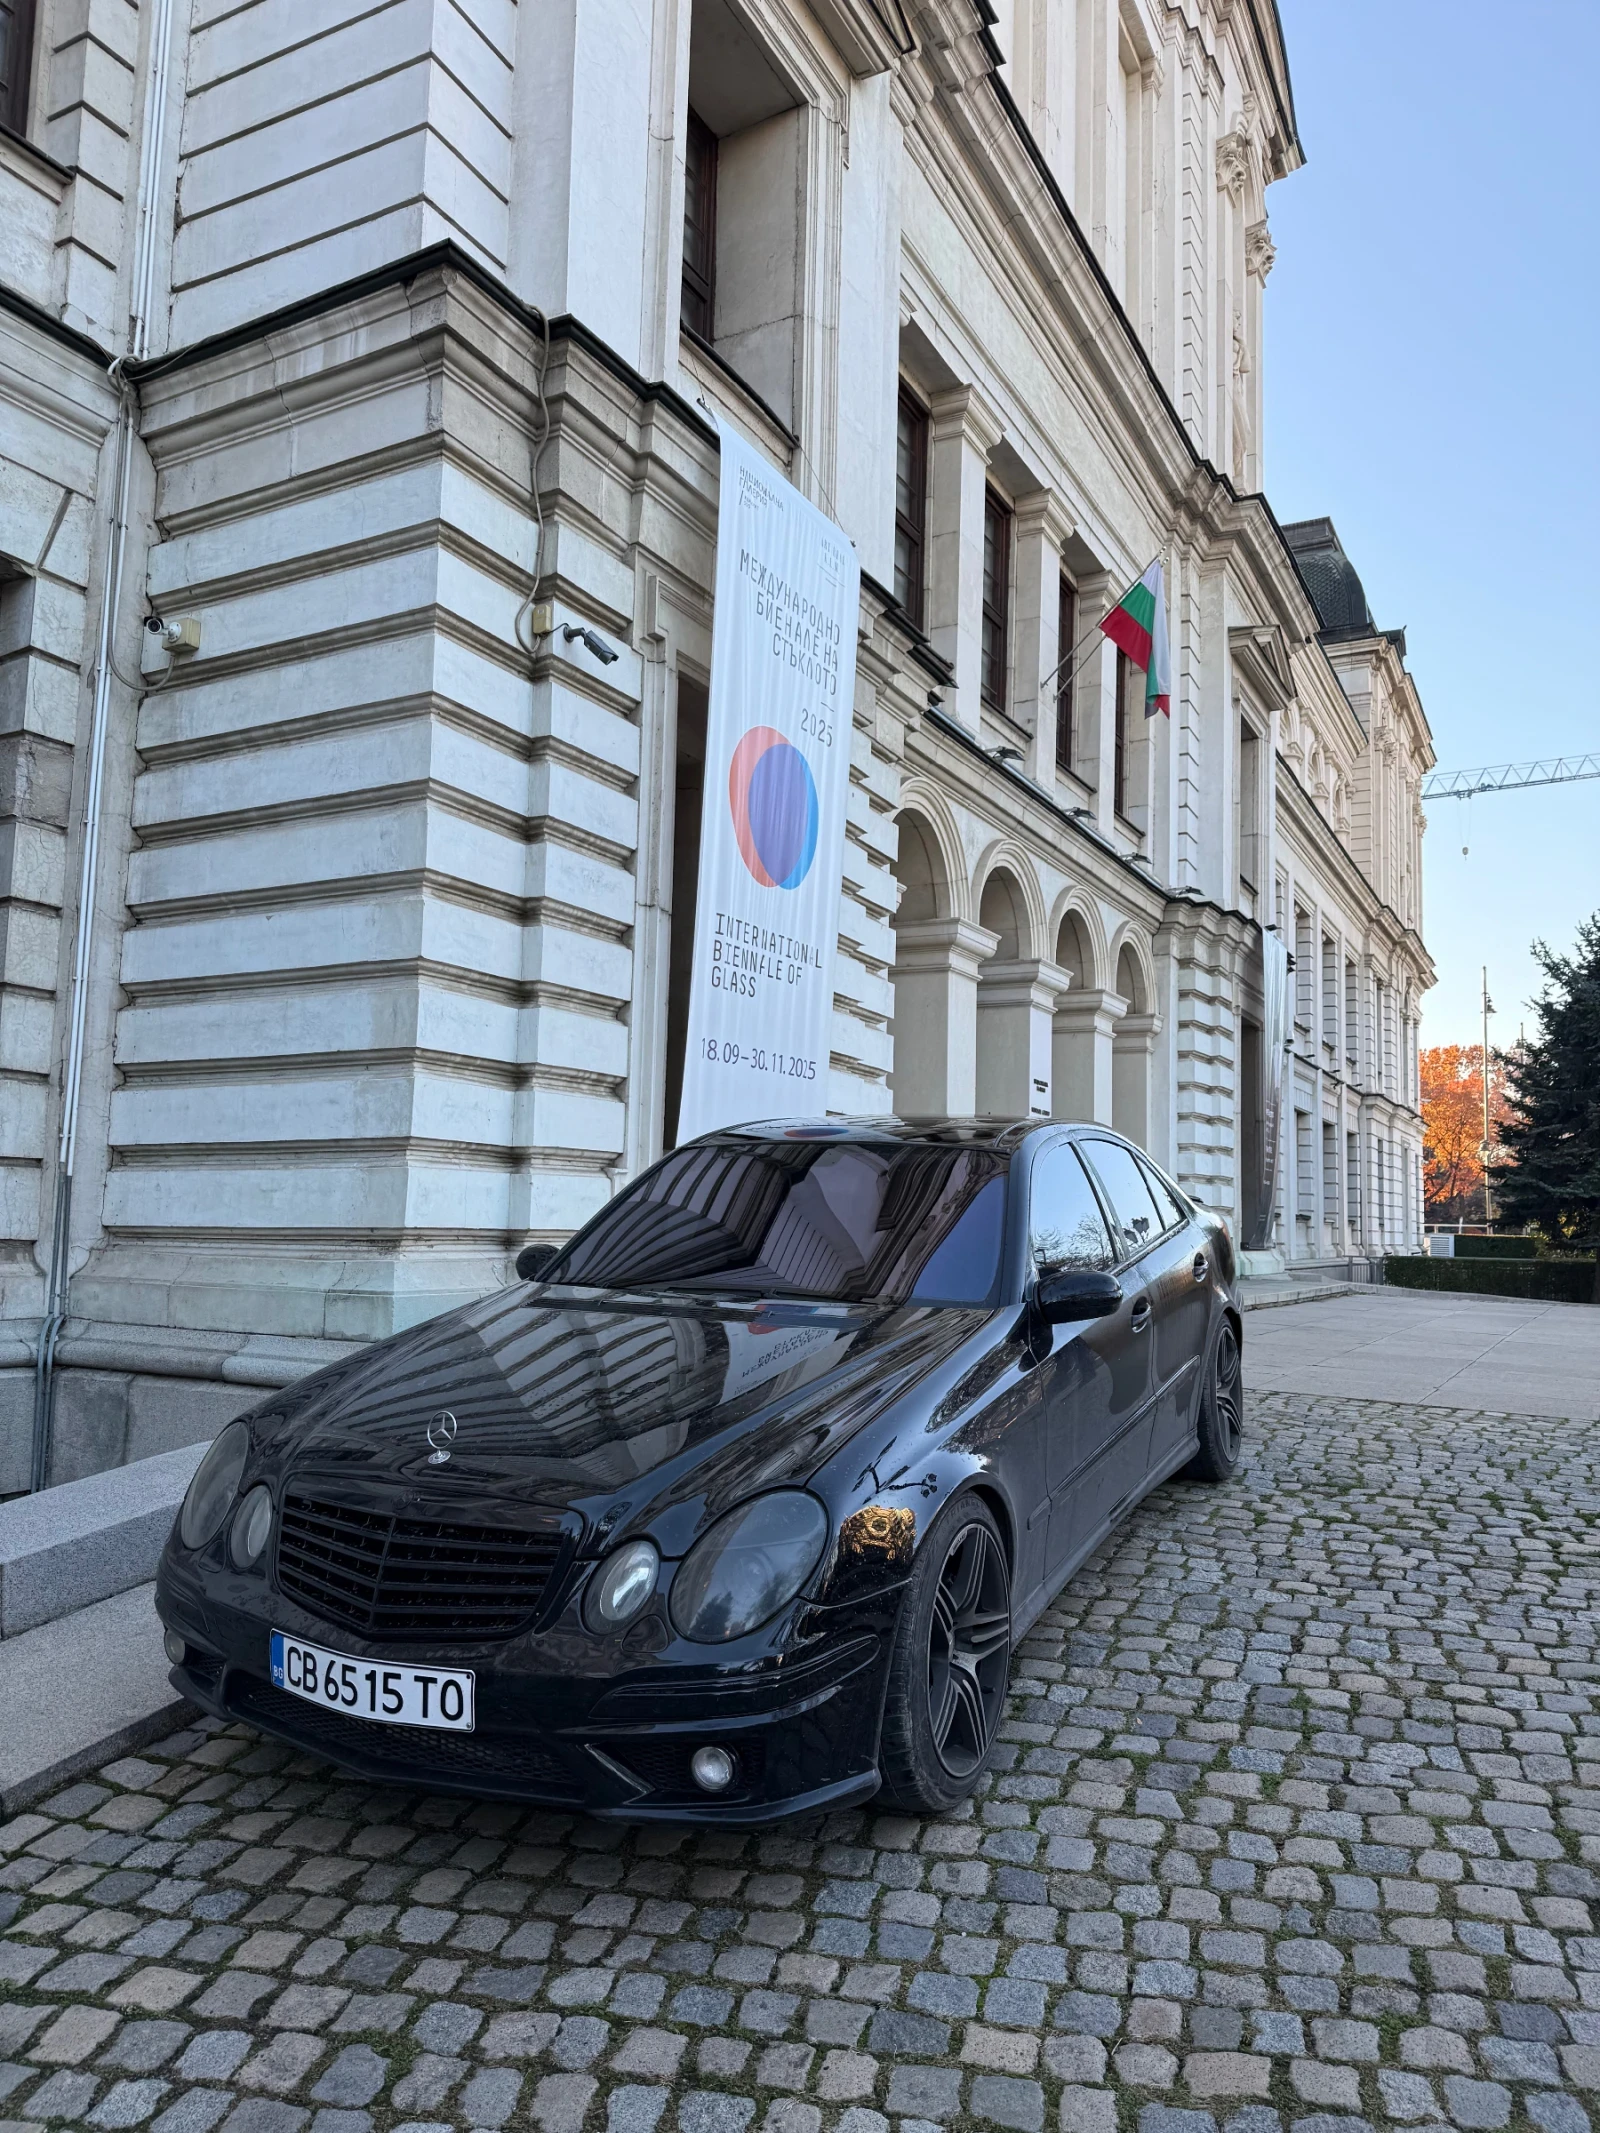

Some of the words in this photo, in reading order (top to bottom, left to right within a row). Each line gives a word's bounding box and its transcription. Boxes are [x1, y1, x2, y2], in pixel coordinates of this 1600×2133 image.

[740, 548, 842, 645] МЕЖДУНАРОДНО
[756, 591, 820, 658] БИЕНАЛЕ
[823, 640, 839, 672] НА
[772, 635, 838, 696] СТЪКЛОТО
[800, 707, 833, 748] 2025
[713, 939, 782, 981] BIENNALE
[787, 963, 803, 986] OF
[715, 912, 823, 969] INTERNATIONAL
[711, 965, 757, 998] GLASS
[273, 1664, 284, 1680] BG
